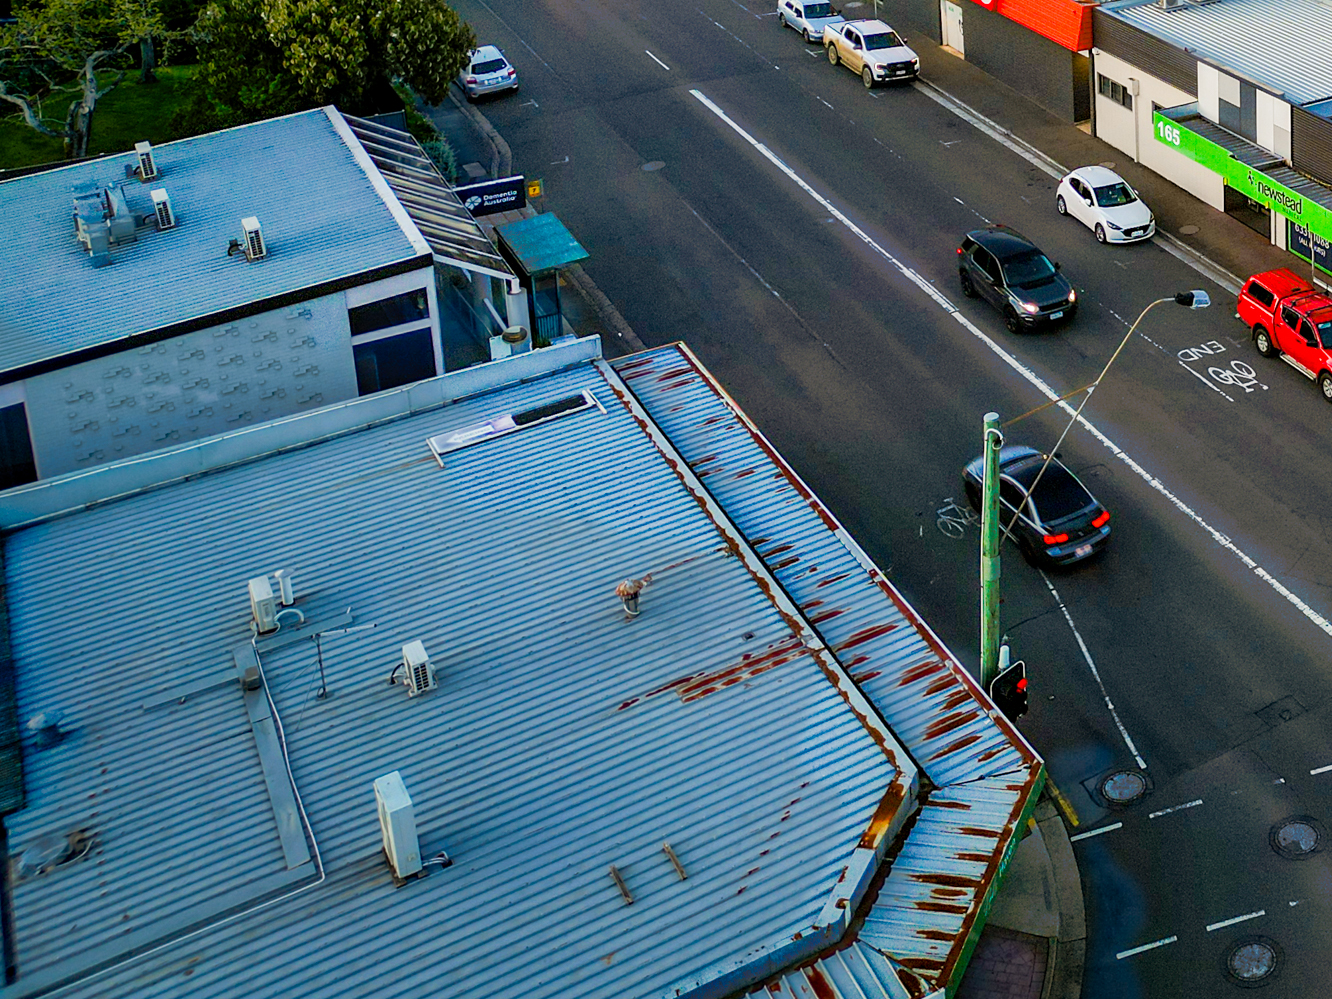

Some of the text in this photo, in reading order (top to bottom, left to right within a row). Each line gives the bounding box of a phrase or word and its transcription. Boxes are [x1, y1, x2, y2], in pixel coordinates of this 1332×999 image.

[1158, 120, 1180, 146] 165
[483, 190, 517, 200] Dementia
[483, 196, 516, 206] Australia
[1257, 181, 1302, 215] newstead
[1177, 340, 1226, 361] END
